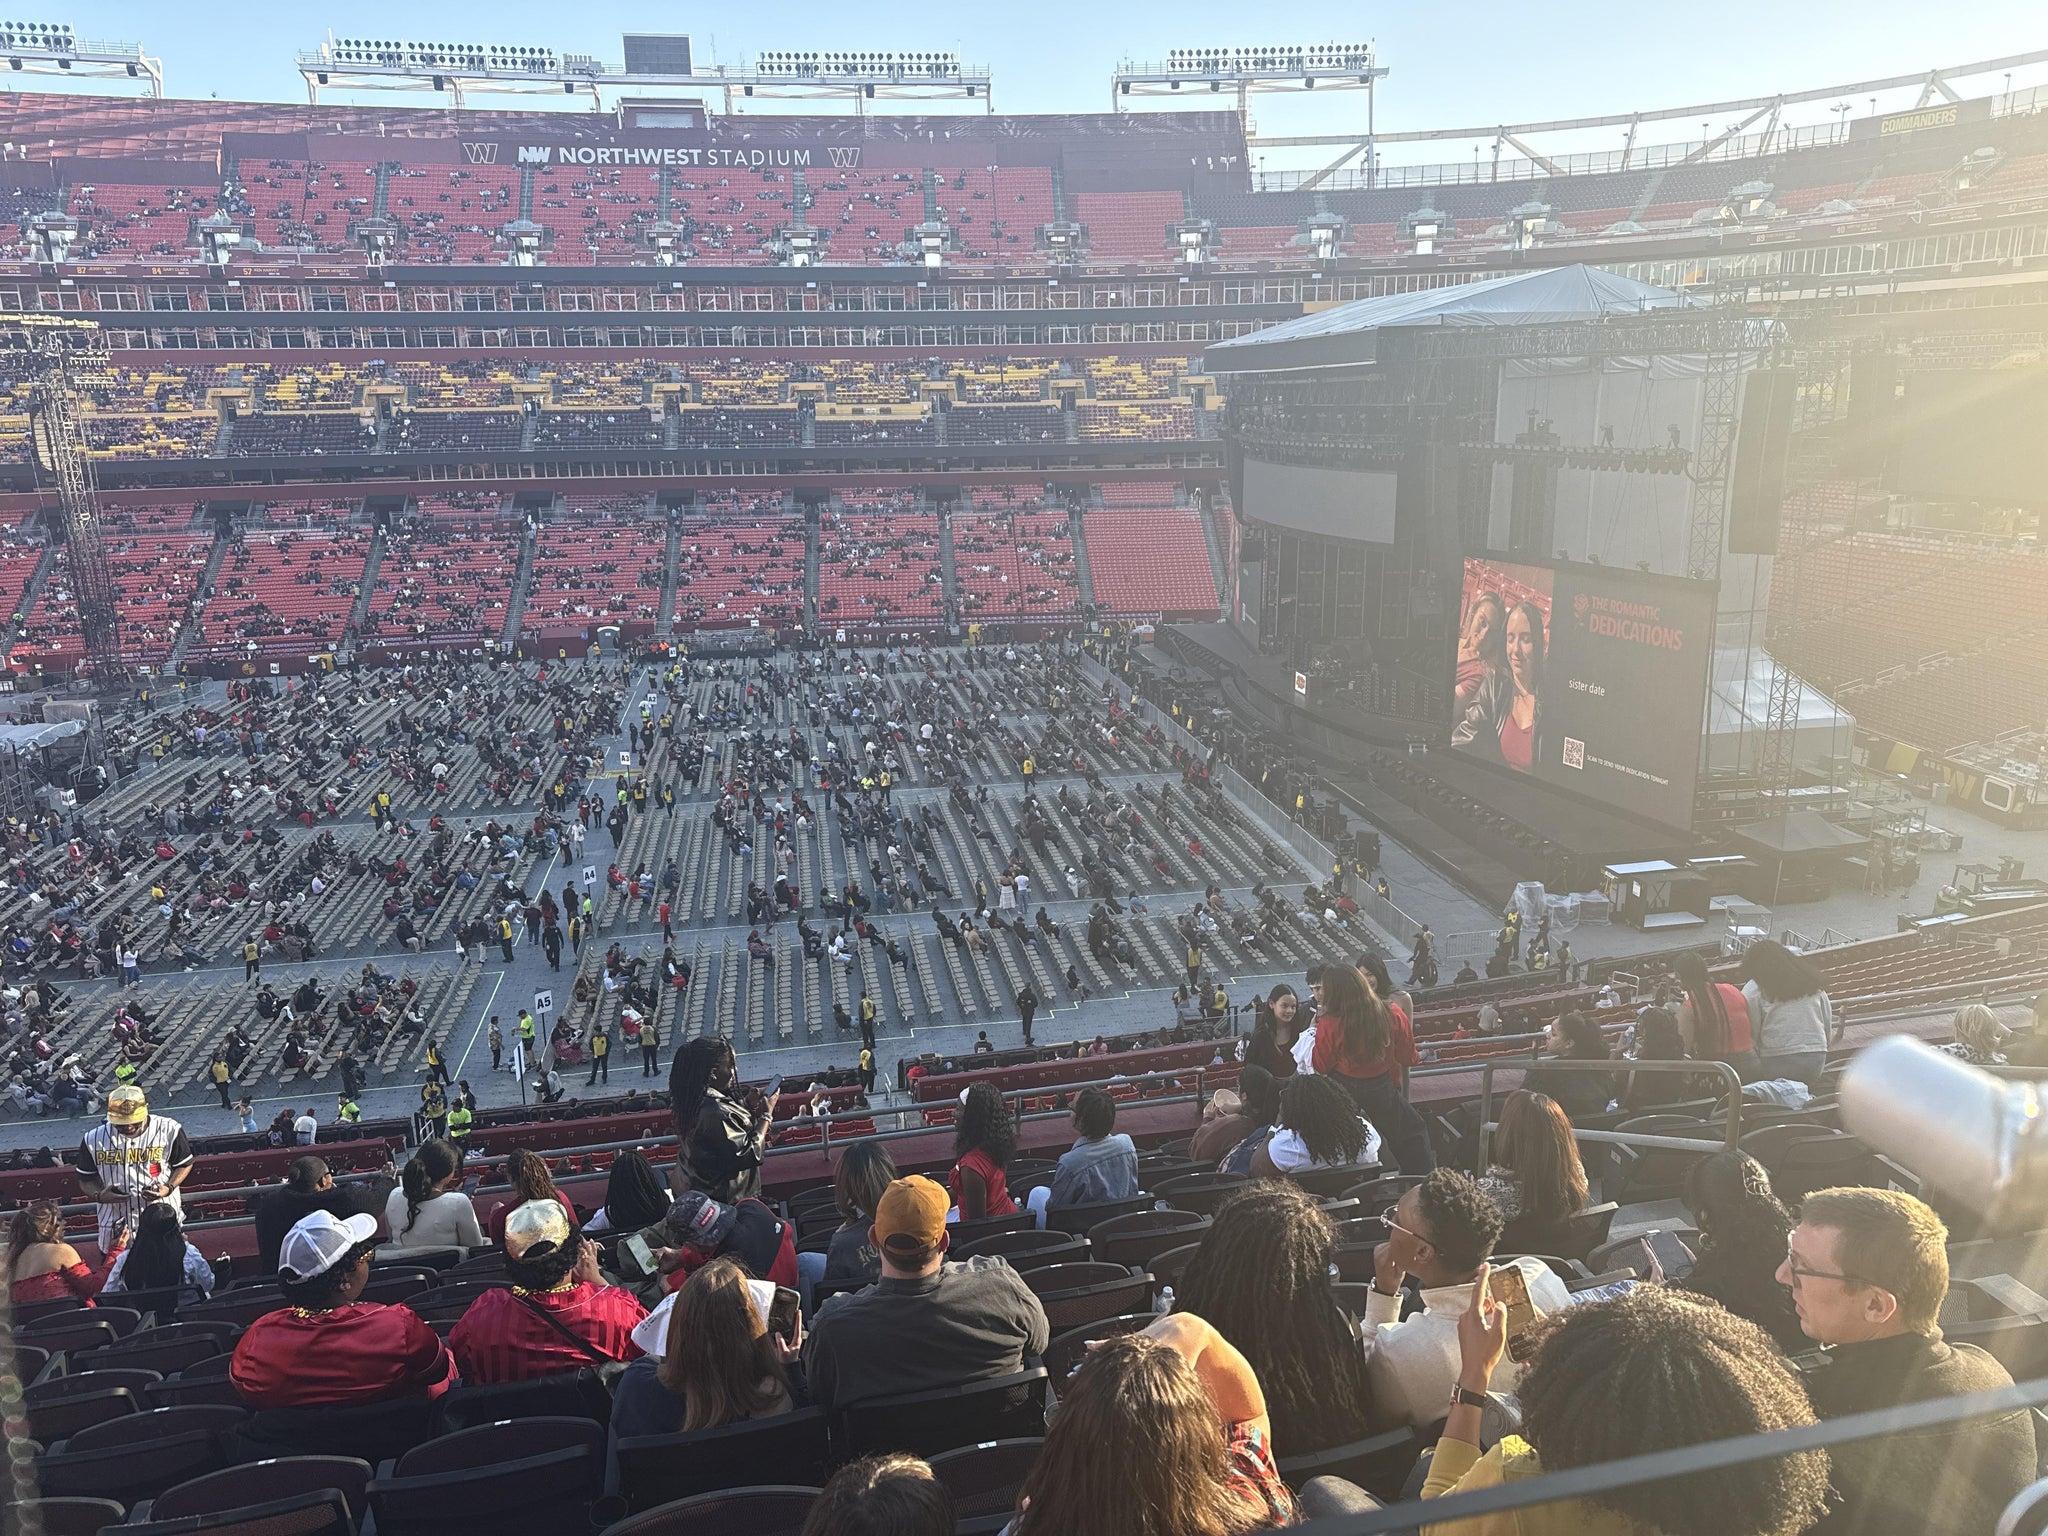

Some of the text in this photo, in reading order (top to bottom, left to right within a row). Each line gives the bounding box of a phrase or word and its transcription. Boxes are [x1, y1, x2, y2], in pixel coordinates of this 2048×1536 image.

[1881, 109, 1957, 133] COMMANDERS
[559, 147, 702, 165] NORTHWEST
[707, 149, 811, 166] STADIUM
[1591, 595, 1661, 620] THE ROMANTIC
[1589, 613, 1683, 650] DEDICATIONS
[1569, 678, 1605, 697] sister date
[1587, 755, 1598, 763] SCAN
[1603, 760, 1614, 768] SEND
[1614, 763, 1625, 772] YOUR
[1625, 767, 1650, 780] DEDICATION
[1650, 775, 1669, 785] TONIGHT
[584, 870, 595, 881] A4
[537, 996, 551, 1009] A5
[95, 1146, 164, 1165] PEANUTS
